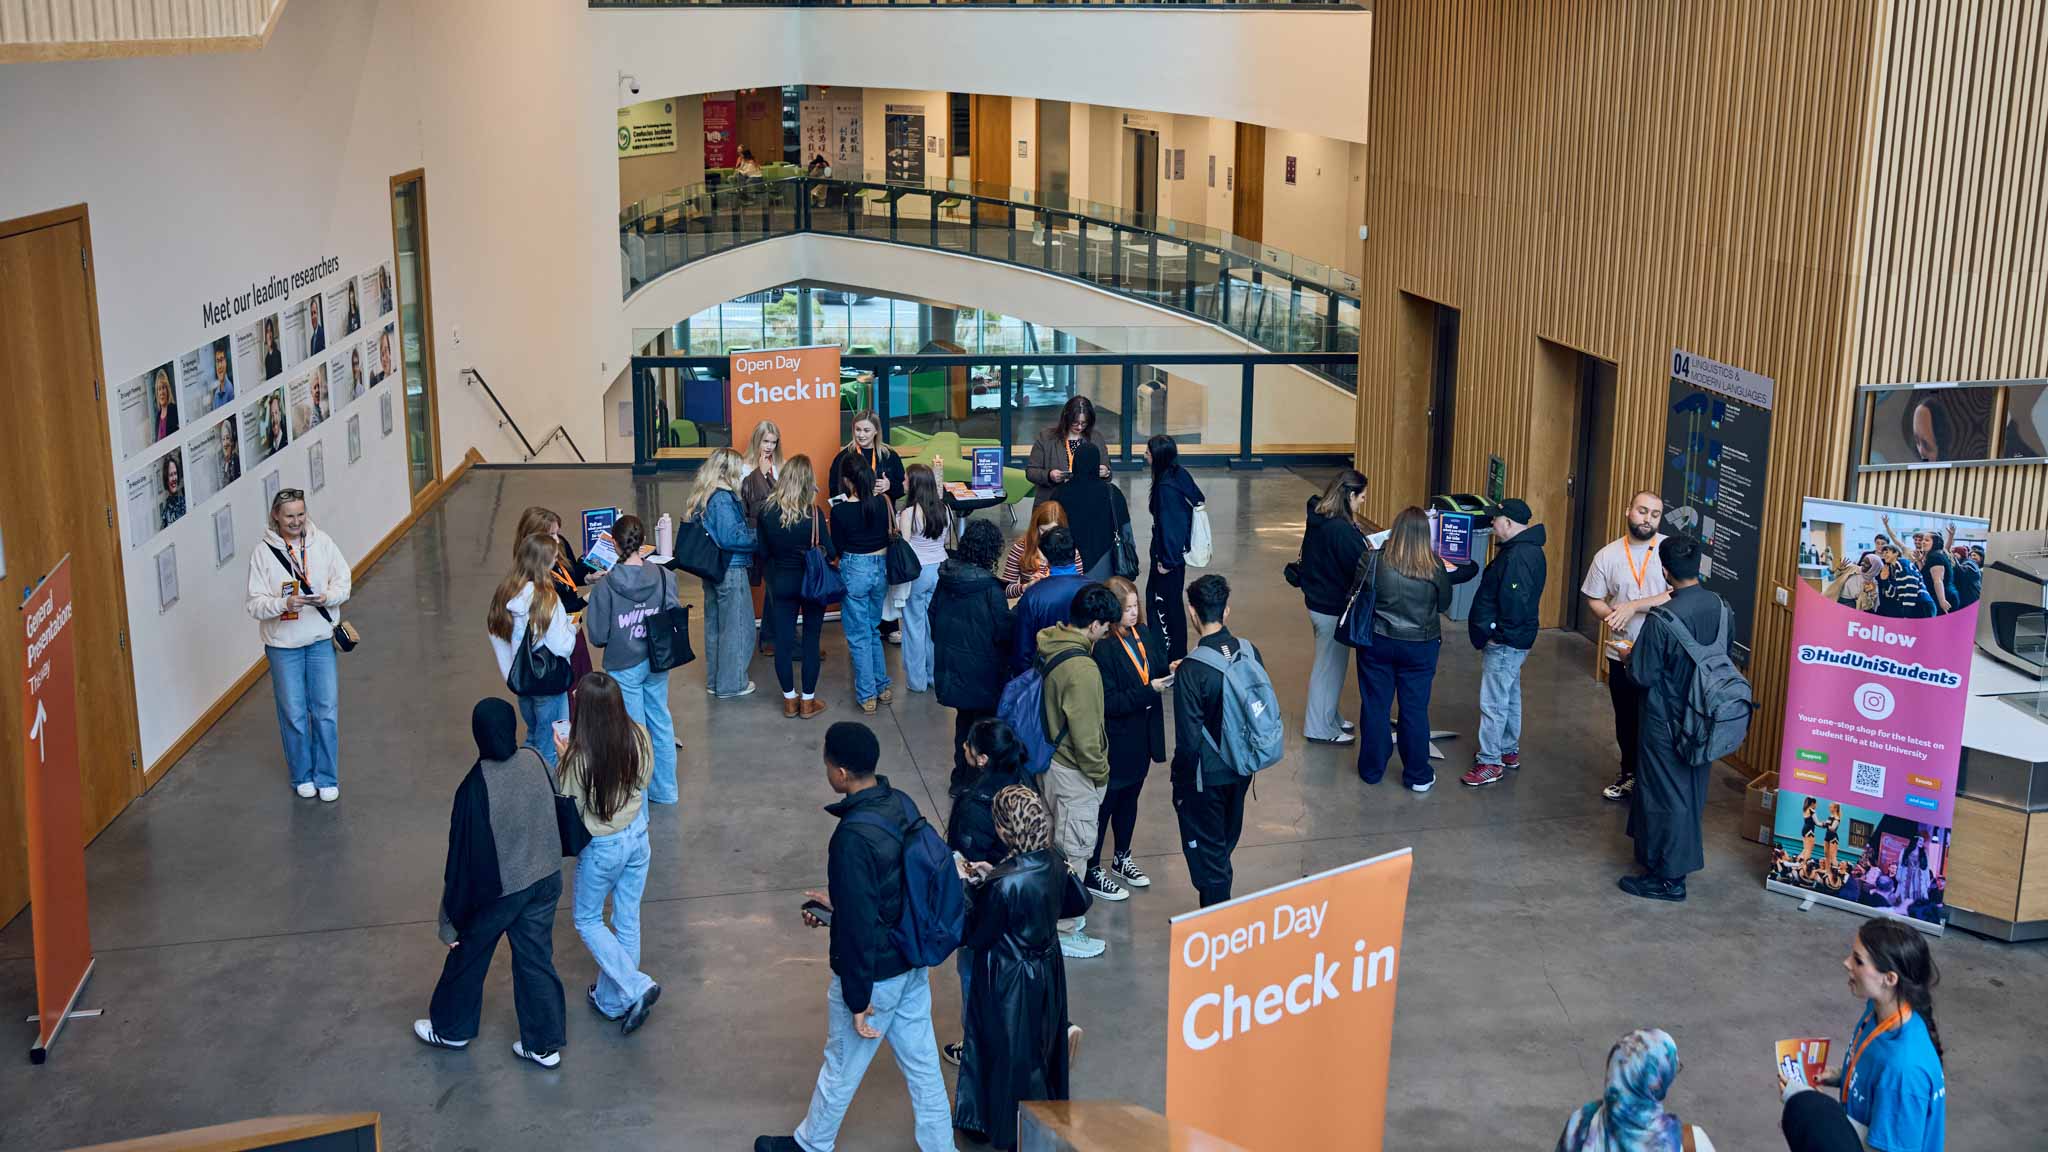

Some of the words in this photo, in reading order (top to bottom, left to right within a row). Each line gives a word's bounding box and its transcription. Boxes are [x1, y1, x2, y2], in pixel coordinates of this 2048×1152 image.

[202, 297, 232, 329] Meet
[233, 291, 251, 314] our
[253, 273, 289, 307] leading
[290, 255, 339, 290] researchers
[736, 358, 773, 374] Open
[775, 355, 801, 372] Day
[1674, 353, 1690, 377] 04
[1691, 358, 1733, 380] LINGUISTICS
[1734, 372, 1741, 381] &
[737, 378, 811, 405] Check
[815, 377, 836, 399] in
[1691, 371, 1721, 389] MODERN
[1722, 382, 1768, 404] LANGUAGES
[26, 589, 54, 639] General
[27, 600, 73, 668] Presentations
[1847, 620, 1917, 649] Follow
[1801, 648, 1958, 686] @HudUniStudents
[1798, 713, 1817, 723] Your
[1818, 718, 1855, 731] one-stop
[1856, 724, 1877, 736] shop
[1877, 726, 1891, 738] for
[1892, 731, 1906, 742] the
[1907, 733, 1932, 747] latest
[1933, 742, 1945, 750] on
[1812, 728, 1843, 741] student
[1844, 734, 1858, 744] life
[1859, 738, 1868, 746] at
[1869, 738, 1884, 749] the
[1885, 743, 1928, 760] University
[1183, 920, 1265, 972] Open
[1273, 901, 1329, 940] Day
[1182, 952, 1342, 1051] Check
[1351, 939, 1395, 992] in
